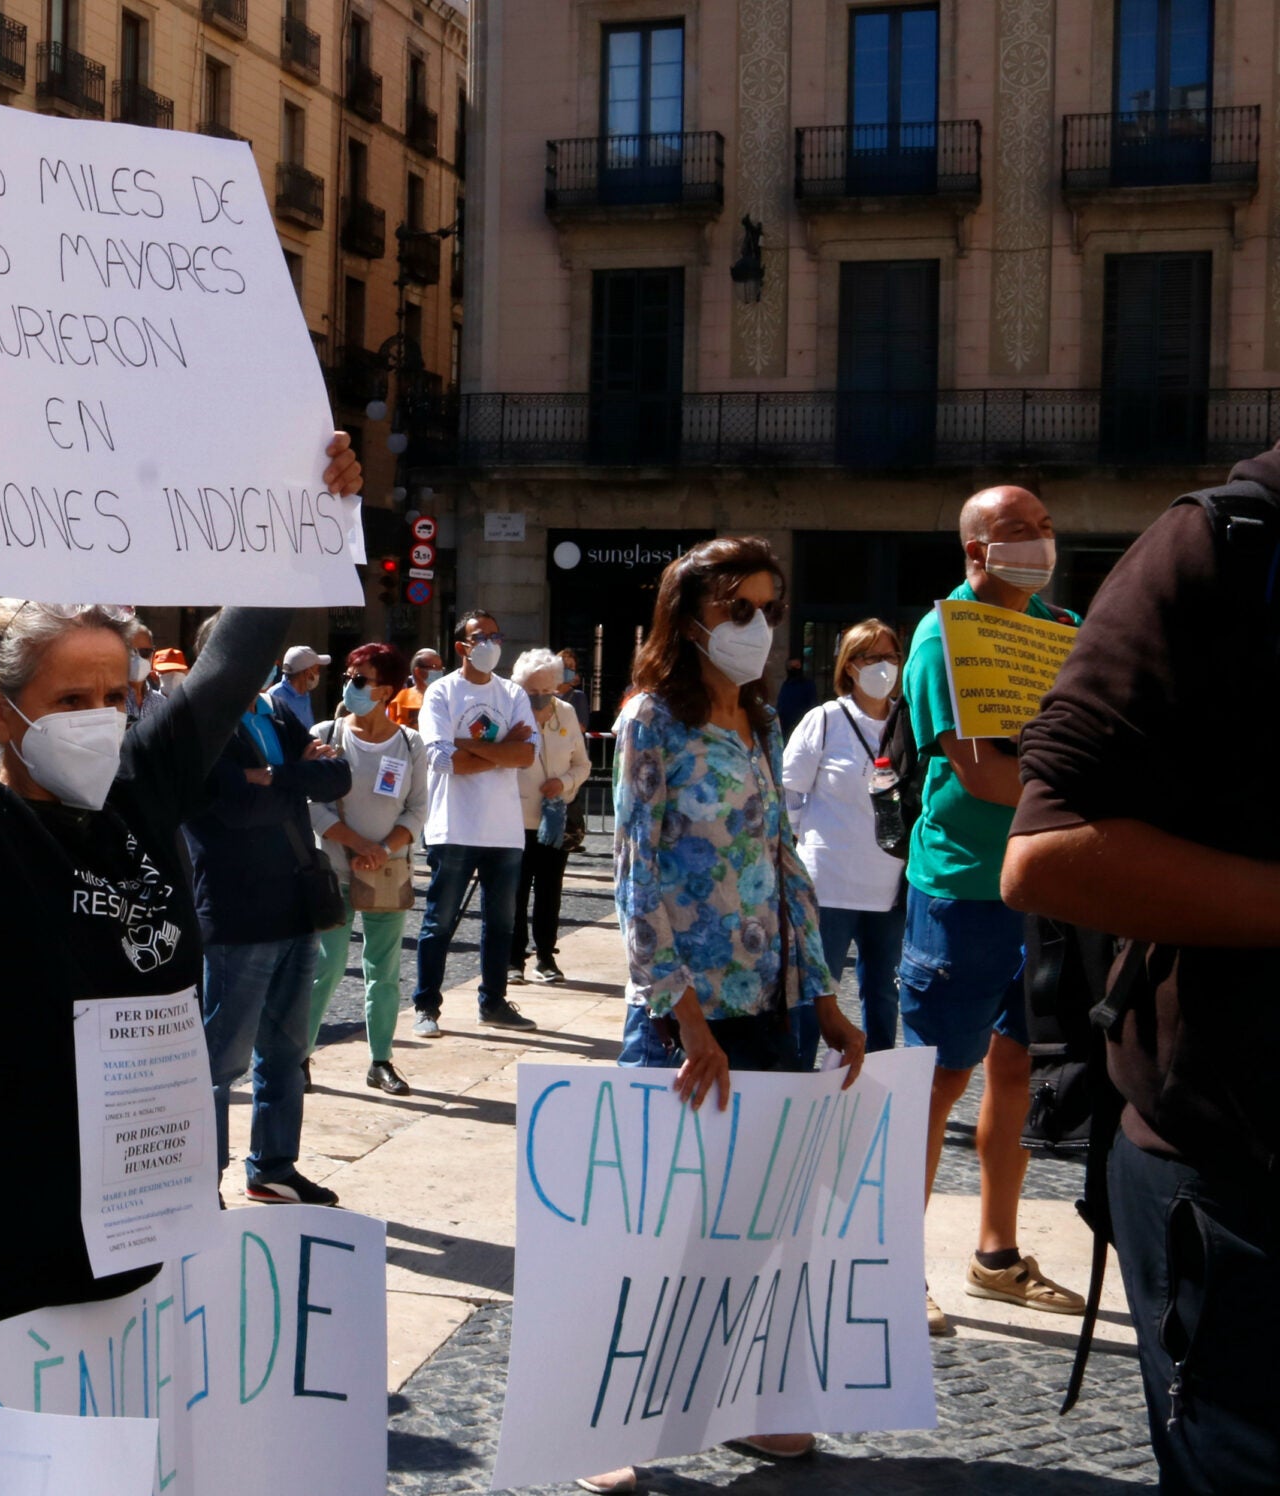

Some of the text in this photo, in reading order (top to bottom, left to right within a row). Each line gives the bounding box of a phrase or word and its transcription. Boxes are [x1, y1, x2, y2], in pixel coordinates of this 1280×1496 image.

[39, 158, 164, 218] MILES
[192, 176, 244, 225] DE
[60, 233, 246, 294] MAYORES
[45, 397, 115, 452] EN
[163, 487, 344, 555] INDIGNAS
[587, 544, 672, 569] sunglass
[955, 657, 979, 667] DRETS
[980, 658, 993, 667] PER
[960, 688, 985, 699] CANVI
[986, 689, 995, 698] DE
[997, 689, 1022, 700] MODEL
[978, 704, 1011, 714] CARTERA
[116, 1003, 189, 1022] PER DIGNITAT
[109, 1026, 155, 1040] DRETS
[116, 1119, 191, 1144] POR DIGNIDAD
[124, 1136, 186, 1160] ¡DERECHOS
[124, 1152, 183, 1175] HUMANOS!
[240, 1232, 355, 1405] DE
[589, 1258, 892, 1428] HUMANS
